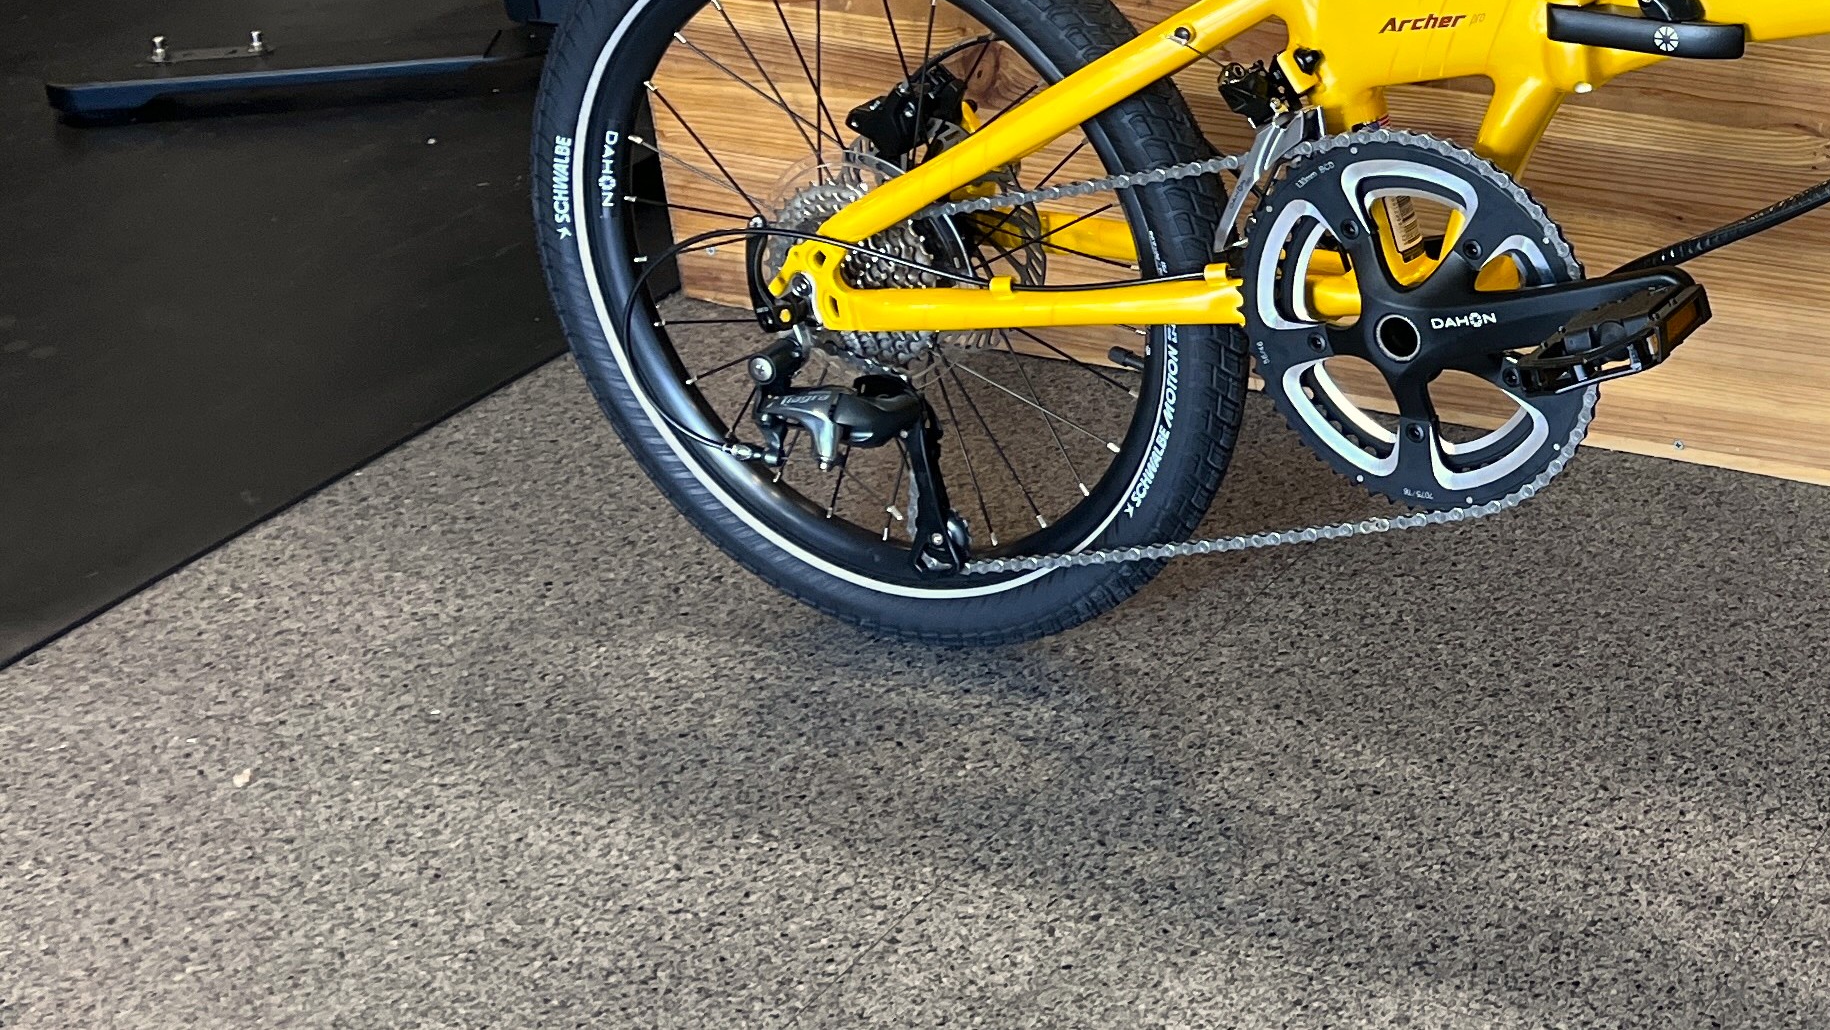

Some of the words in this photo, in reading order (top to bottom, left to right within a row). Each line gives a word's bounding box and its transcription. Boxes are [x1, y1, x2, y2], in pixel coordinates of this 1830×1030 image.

[1378, 13, 1467, 35] Archer
[553, 135, 572, 223] SCHWALBE
[598, 130, 619, 207] DAHON
[1430, 312, 1497, 329] DAHON
[1131, 425, 1171, 508] SCHWALBE
[1163, 344, 1179, 428] MOTION
